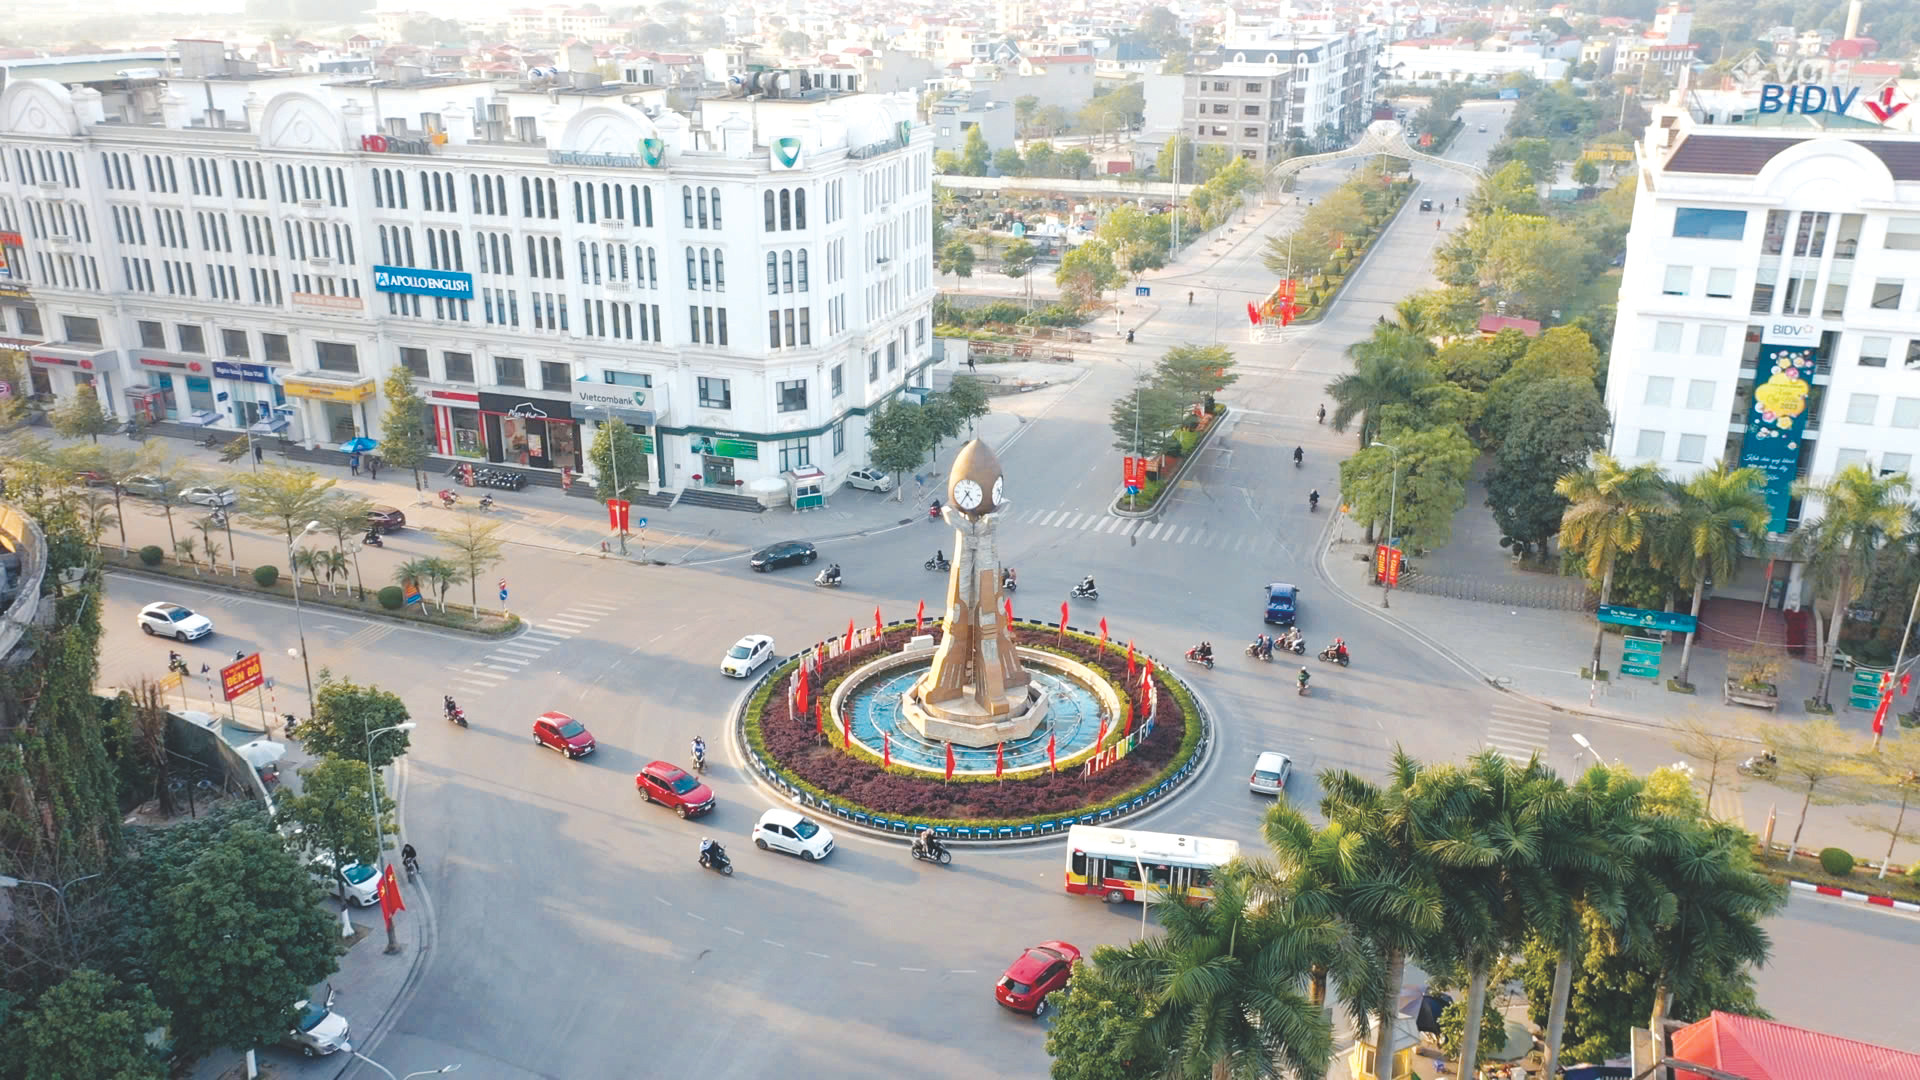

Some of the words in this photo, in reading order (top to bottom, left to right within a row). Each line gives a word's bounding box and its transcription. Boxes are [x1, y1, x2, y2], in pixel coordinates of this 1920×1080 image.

[1760, 84, 1860, 115] BIDV
[390, 275, 427, 288] APOLLO
[428, 278, 470, 292] ENGLISH
[1772, 324, 1801, 335] BIDV
[579, 391, 633, 406] Vietcombank
[508, 409, 525, 418] Pizza
[525, 411, 538, 419] Hut
